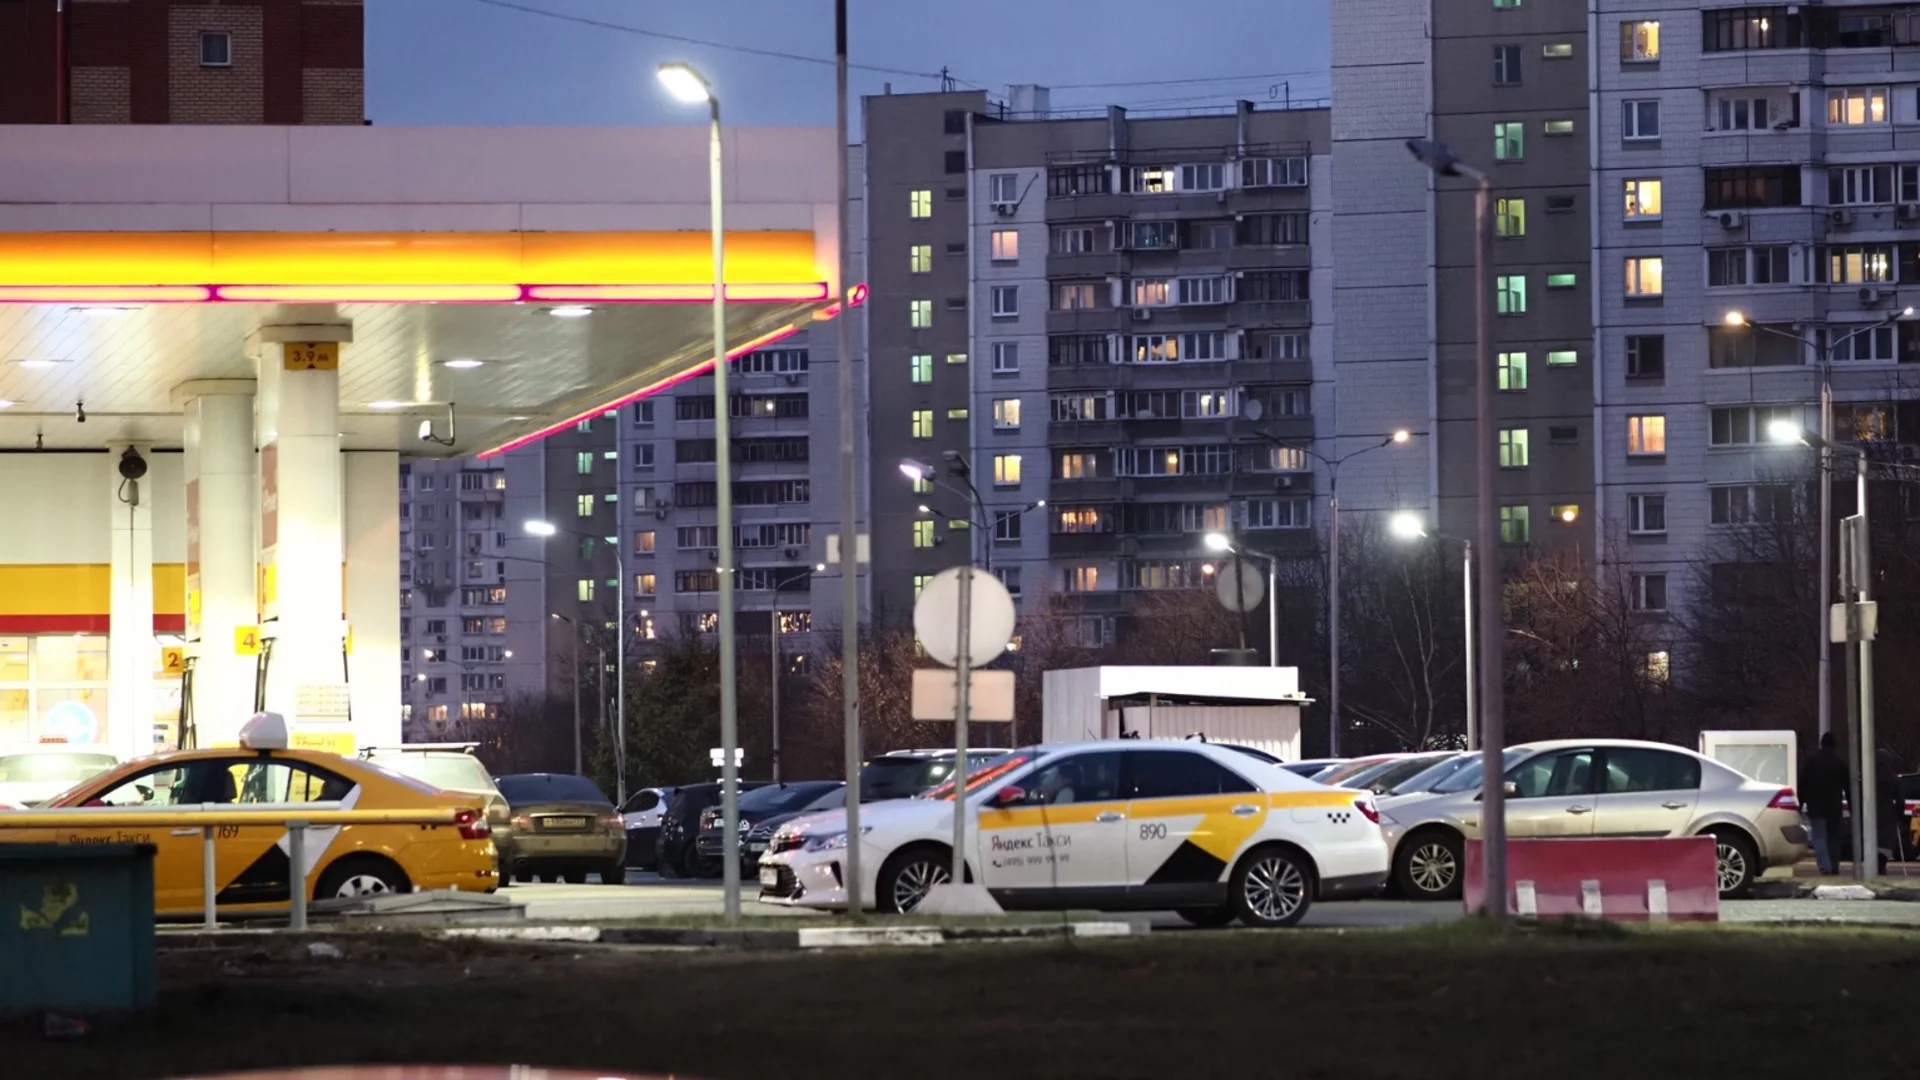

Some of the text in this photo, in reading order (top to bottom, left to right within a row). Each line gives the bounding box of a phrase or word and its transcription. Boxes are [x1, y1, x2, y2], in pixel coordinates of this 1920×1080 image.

[243, 633, 256, 649] 4
[168, 652, 179, 667] 2
[1140, 824, 1167, 840] 890
[991, 832, 1072, 851] Яндекс Такси
